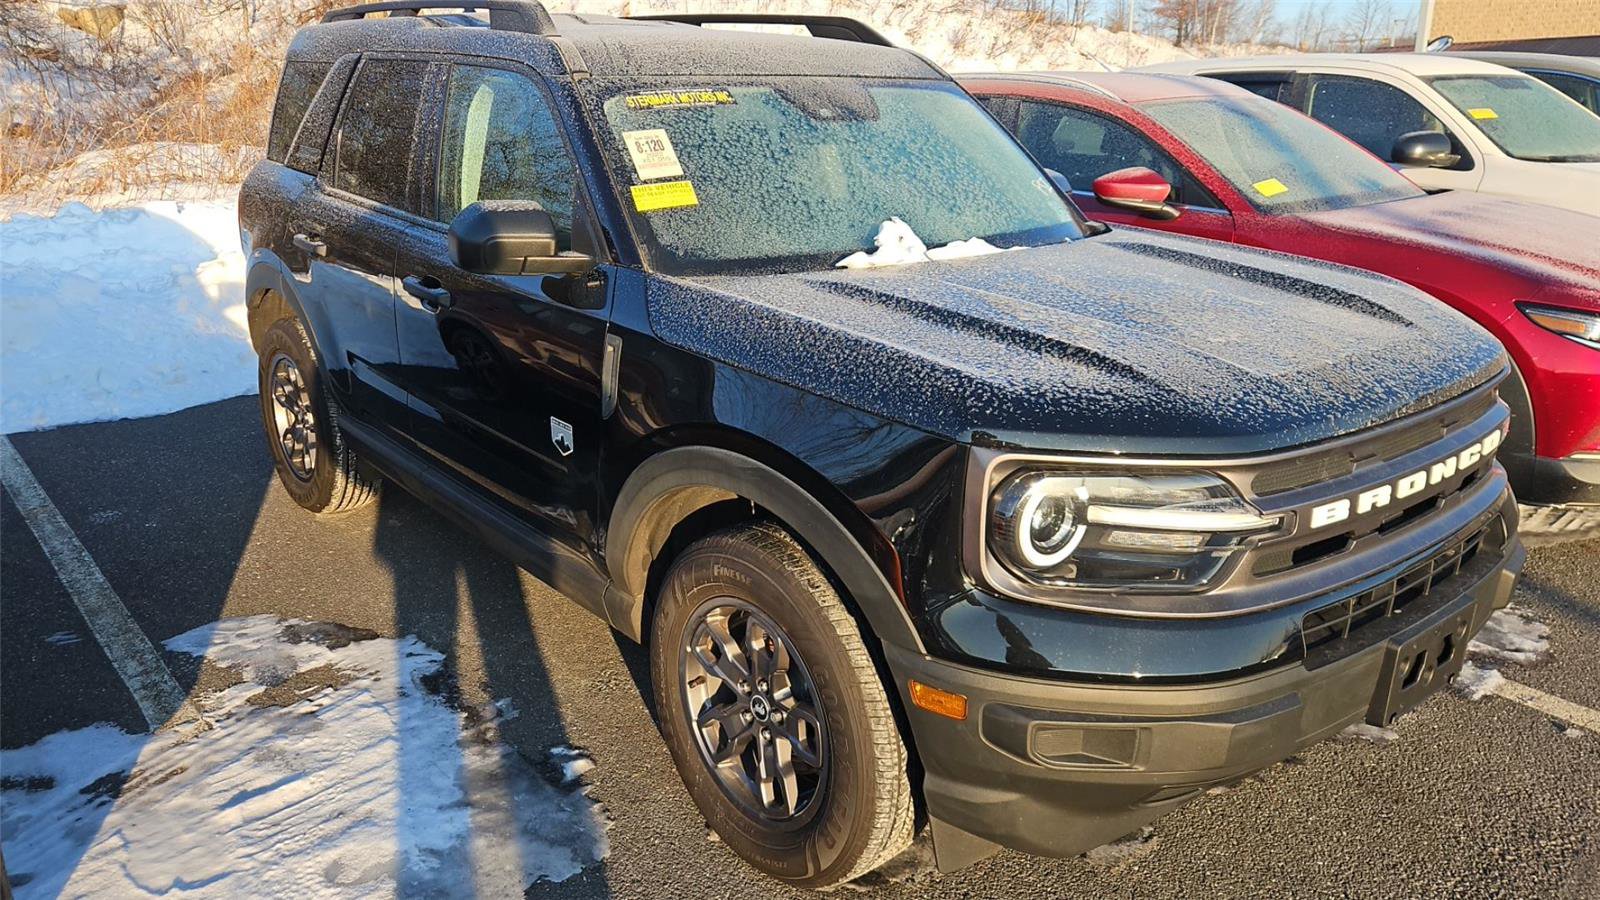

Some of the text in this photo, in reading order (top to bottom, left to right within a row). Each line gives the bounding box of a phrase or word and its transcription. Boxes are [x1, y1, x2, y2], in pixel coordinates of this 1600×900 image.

[677, 91, 716, 105] MOTORS
[635, 138, 665, 154] 8:120
[1310, 429, 1501, 529] BRONCO
